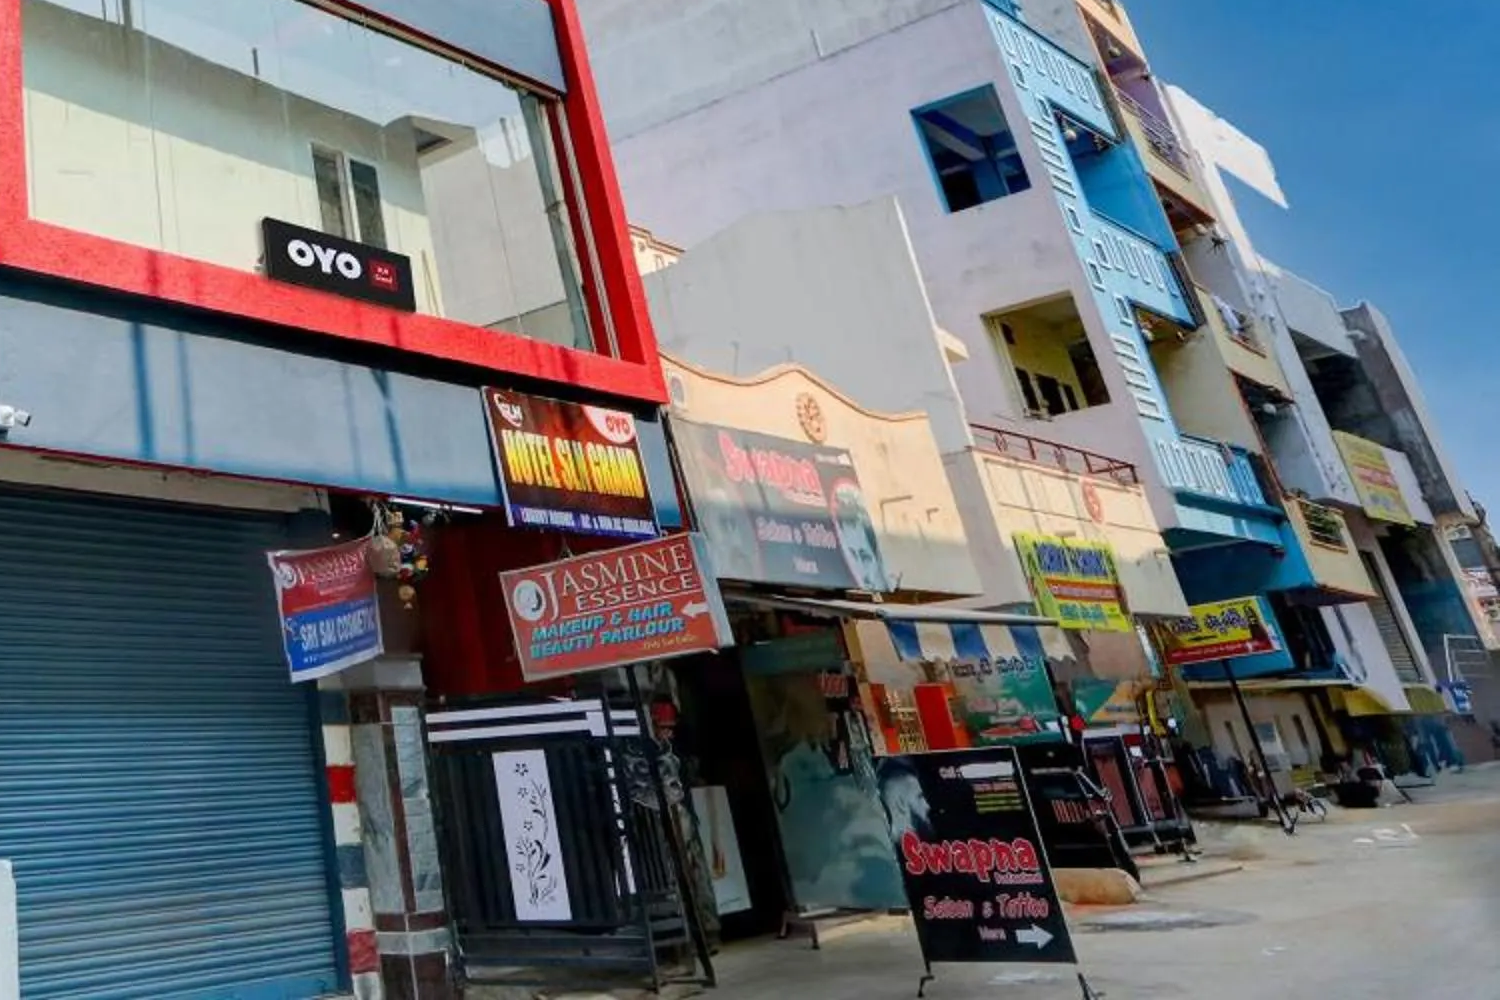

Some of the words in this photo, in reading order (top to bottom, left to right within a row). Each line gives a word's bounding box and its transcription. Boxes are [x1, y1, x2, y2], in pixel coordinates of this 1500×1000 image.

[287, 239, 362, 279] OYO
[605, 415, 631, 434] OYO
[501, 429, 561, 488] HOTEL
[585, 441, 645, 498] GRAND
[540, 543, 693, 621] JASMINE
[575, 573, 694, 612] ESSENCE
[301, 622, 319, 652] SRI
[530, 634, 595, 659] BEAUTY
[601, 617, 686, 645] PARLOUR
[532, 614, 605, 640] MAKEUP
[610, 610, 622, 625] &
[628, 601, 674, 621] HAIR
[901, 828, 1040, 883] Swapna
